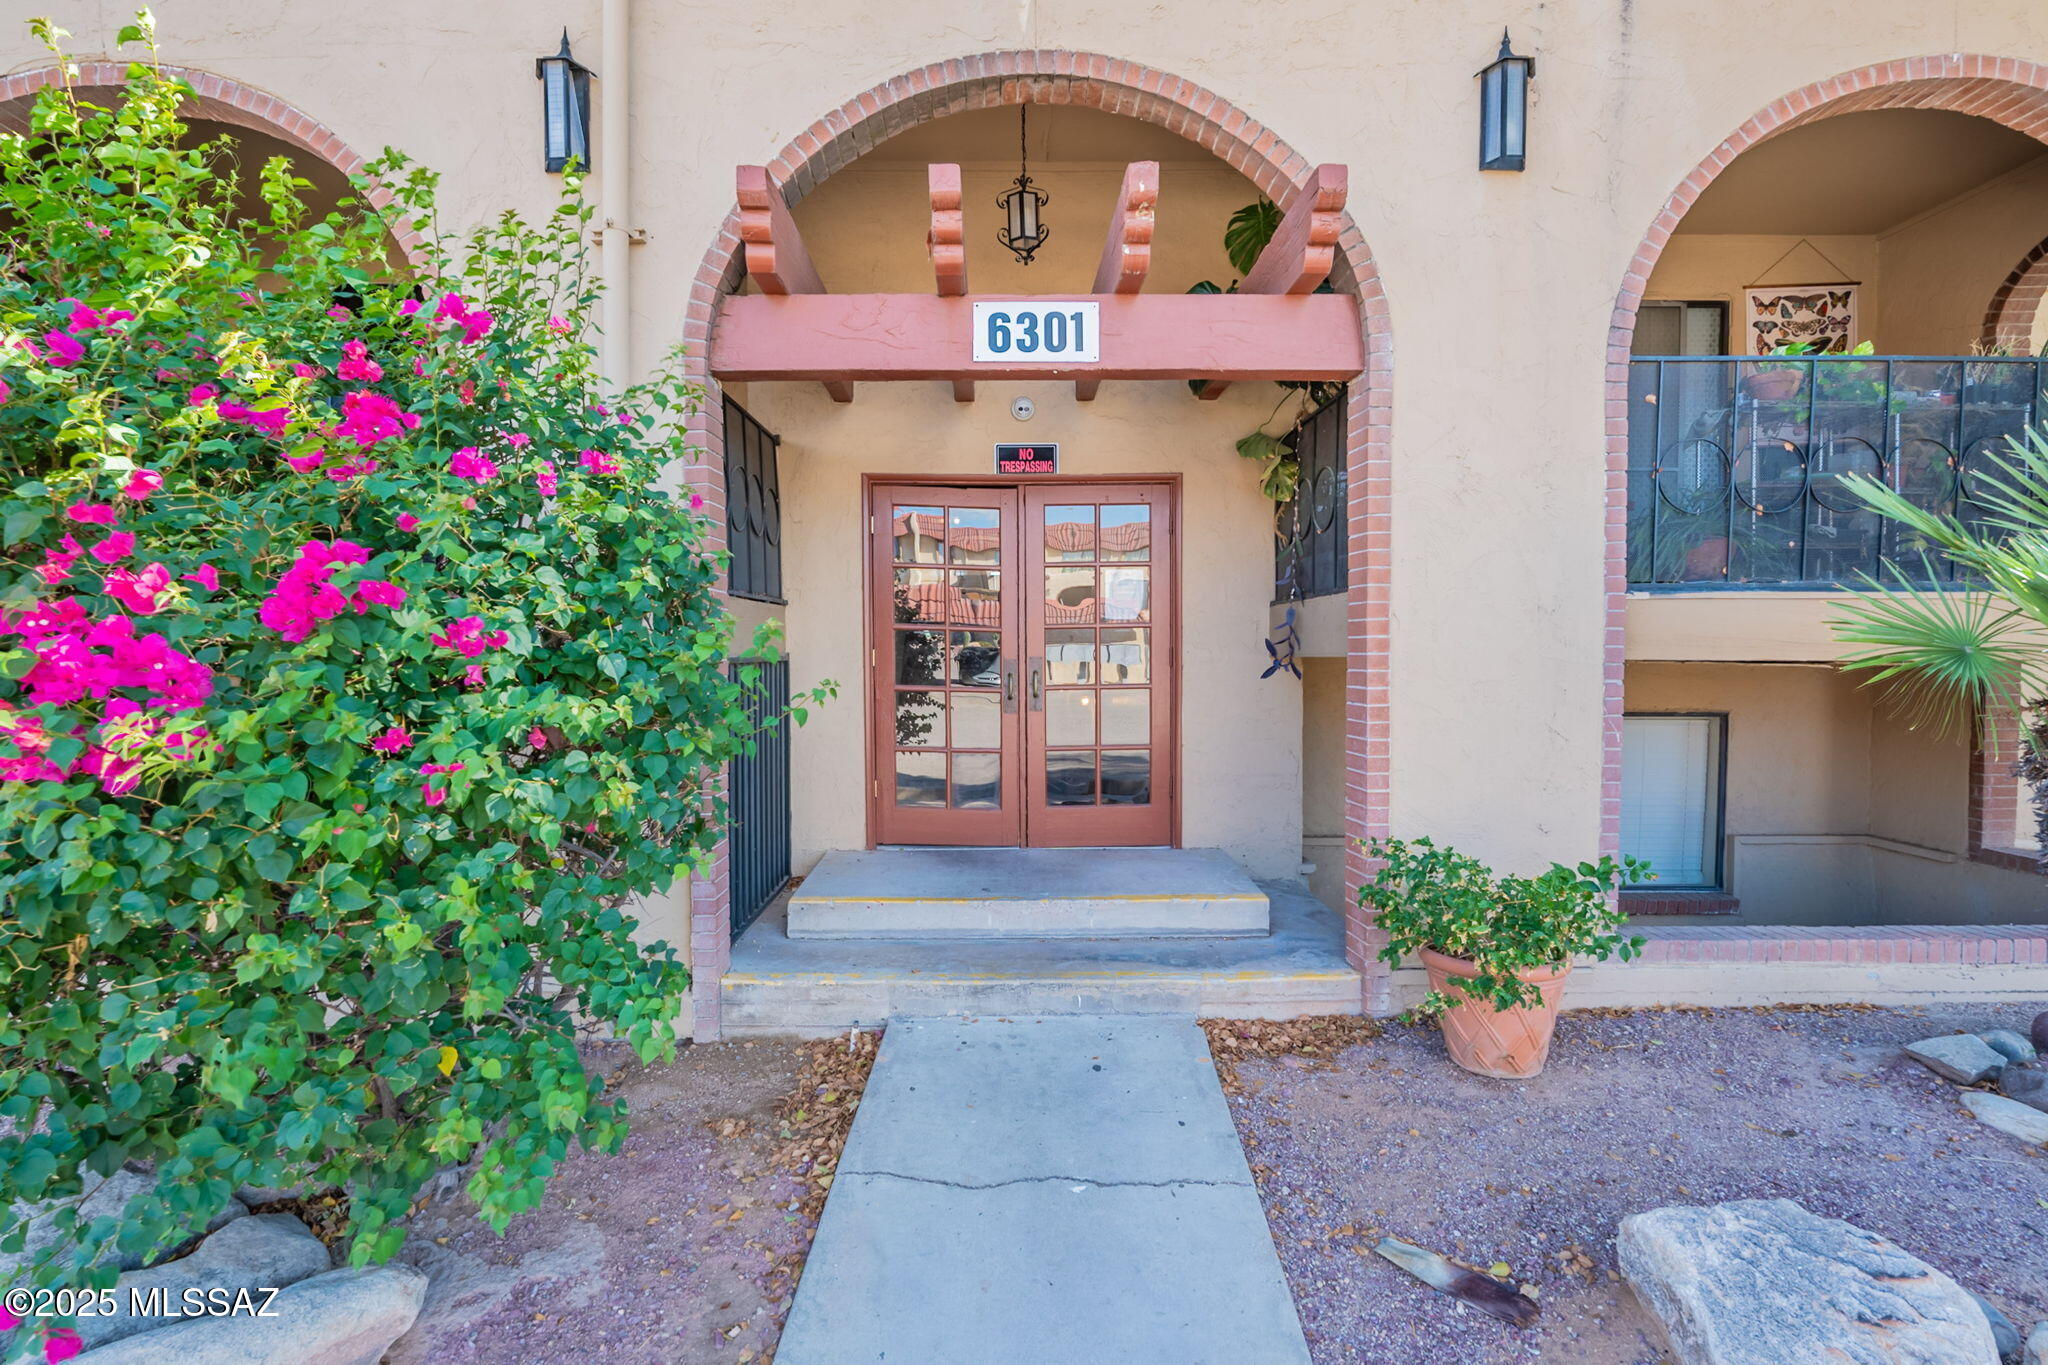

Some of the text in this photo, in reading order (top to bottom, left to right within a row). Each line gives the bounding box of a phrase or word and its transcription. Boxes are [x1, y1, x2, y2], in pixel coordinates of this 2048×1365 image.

[988, 311, 1083, 353] 6301
[1019, 448, 1034, 460] NO
[1000, 461, 1054, 473] TRESPASSING
